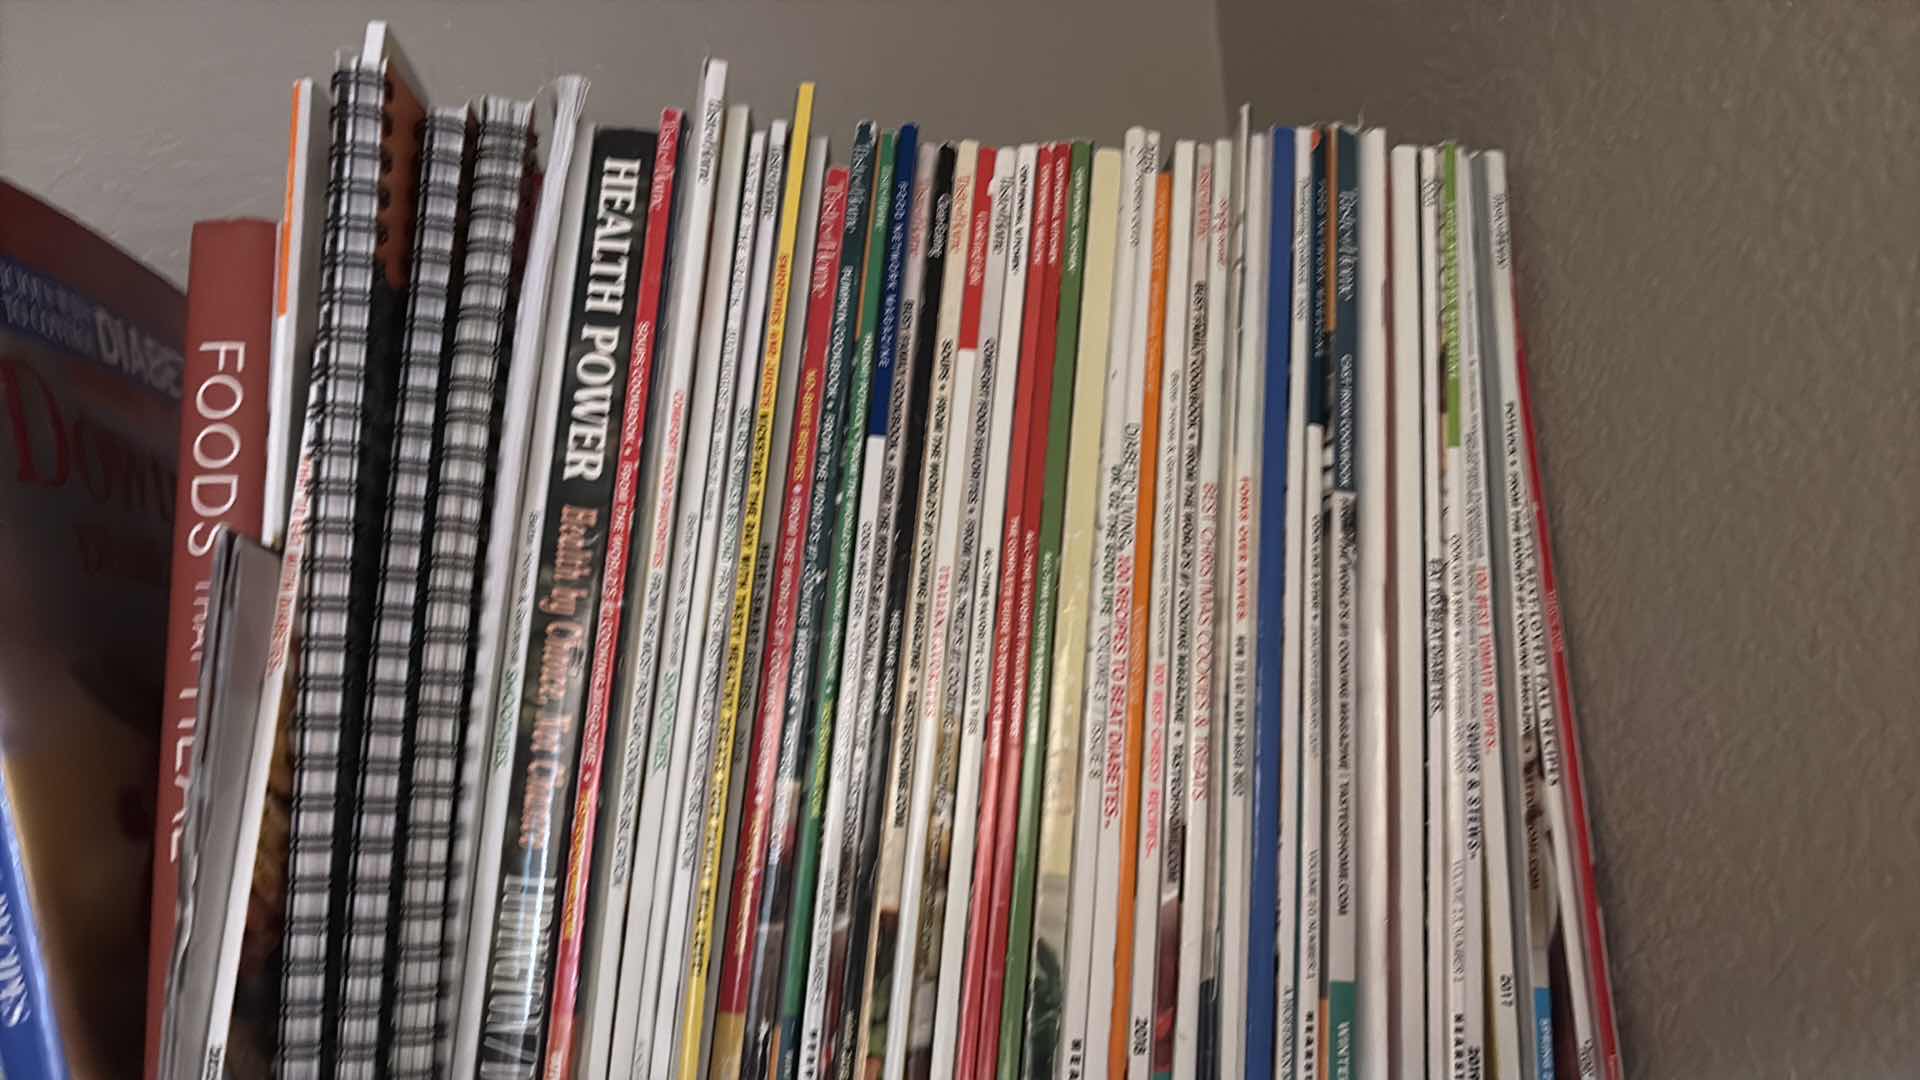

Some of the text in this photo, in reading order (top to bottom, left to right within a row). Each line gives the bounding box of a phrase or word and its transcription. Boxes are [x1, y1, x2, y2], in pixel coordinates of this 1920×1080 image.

[769, 254, 789, 326] SMOOTHIES
[832, 266, 852, 322] PUMPKIN
[876, 182, 908, 368] FOOD NETWORK MAGAZINE
[562, 156, 641, 484] HEALTH POWER
[631, 320, 650, 366] SOUPS
[765, 330, 780, 357] AND
[759, 360, 776, 408] JUICES
[823, 325, 845, 397] COOKBOOK
[936, 338, 953, 380] SOUPS
[1338, 354, 1351, 408] CAST-IRON
[621, 368, 644, 444] COOKBOOK
[665, 388, 684, 452] COMFORT
[798, 368, 816, 428] NO-BAKE
[931, 395, 947, 432] FROM
[966, 336, 995, 504] COMFORT FOOD FAVORITES
[1186, 358, 1202, 428] COOKBOOK
[187, 341, 246, 557] FOODS
[749, 412, 769, 486] KICKSTART
[792, 431, 809, 482] RECIPES
[817, 412, 834, 451] FROM
[1119, 422, 1139, 492] DIABETIC
[1338, 410, 1351, 488] COOKBOOK
[614, 460, 633, 506] FROM
[659, 456, 677, 494] FOOD
[814, 454, 829, 478] THE
[923, 462, 940, 518] WORLD'S
[1183, 444, 1198, 483] FROM
[745, 490, 760, 517] THE
[786, 494, 801, 532] FROM
[806, 482, 826, 541] WORLD'S
[1116, 494, 1137, 546] LIVING
[1182, 484, 1196, 510] THE
[1200, 482, 1217, 520] BEST
[1237, 476, 1251, 521] FORKS
[550, 504, 598, 583] Health
[650, 496, 672, 568] FAVORITES
[741, 522, 756, 550] DAY
[782, 536, 796, 562] THE
[1104, 514, 1120, 538] THE
[1236, 525, 1250, 562] OVER
[736, 554, 752, 590] WITH
[915, 538, 933, 598] COOKING
[977, 548, 994, 598] ALL-TIME
[1101, 544, 1117, 583] GOOD
[1114, 555, 1134, 584] 100
[1196, 526, 1215, 624] CHRISTMAS
[541, 585, 588, 617] by
[644, 574, 662, 610] FROM
[745, 542, 771, 644] HEART-SMART
[774, 565, 792, 628] WORLD'S
[796, 560, 817, 627] COOKING
[932, 565, 950, 628] ITALIAN
[1098, 586, 1114, 614] LIFE
[1476, 594, 1492, 628] BEST
[266, 596, 298, 675] DIABETES
[641, 614, 657, 638] THE
[729, 594, 747, 647] TASTY
[884, 610, 902, 665] HEALING
[908, 602, 927, 670] MAGAZINE
[972, 600, 989, 656] FAVORITE
[1110, 586, 1132, 654] RECIPES
[1175, 590, 1192, 650] COOKING
[1426, 601, 1444, 639] BEAT
[591, 618, 613, 687] COOKING
[636, 640, 654, 676] MOST
[787, 630, 809, 701] MAGAZINE
[1094, 625, 1112, 684] VOLUME
[1193, 631, 1211, 710] COOKIES
[1336, 640, 1350, 699] COOKING
[1478, 633, 1495, 686] TOMATO
[721, 650, 740, 714] HEALTHY
[764, 650, 783, 713] COOKING
[1106, 685, 1125, 729] BEAT
[1150, 690, 1165, 725] BEST
[1171, 654, 1189, 724] MAGAZINE
[1534, 673, 1553, 709] FALL
[529, 716, 570, 753] Not
[582, 688, 605, 766] MAGAZINE
[1088, 720, 1105, 760] ISSUE
[1336, 701, 1350, 770] MAGAZINE
[1465, 722, 1479, 773] SOUPS
[1481, 692, 1497, 748] RECIPES
[1100, 732, 1122, 818] DIABETES
[1147, 728, 1163, 782] CHEESY
[1189, 734, 1206, 800] TREATS
[1539, 718, 1561, 786] RECIPES
[1144, 788, 1160, 848] RECIPES
[1465, 796, 1480, 851] STEWS
[1335, 782, 1350, 916] TASTEOFHOME.COM
[1499, 974, 1512, 1006] 2017
[1132, 1016, 1147, 1056] 2018
[1537, 1018, 1550, 1068] SPRING
